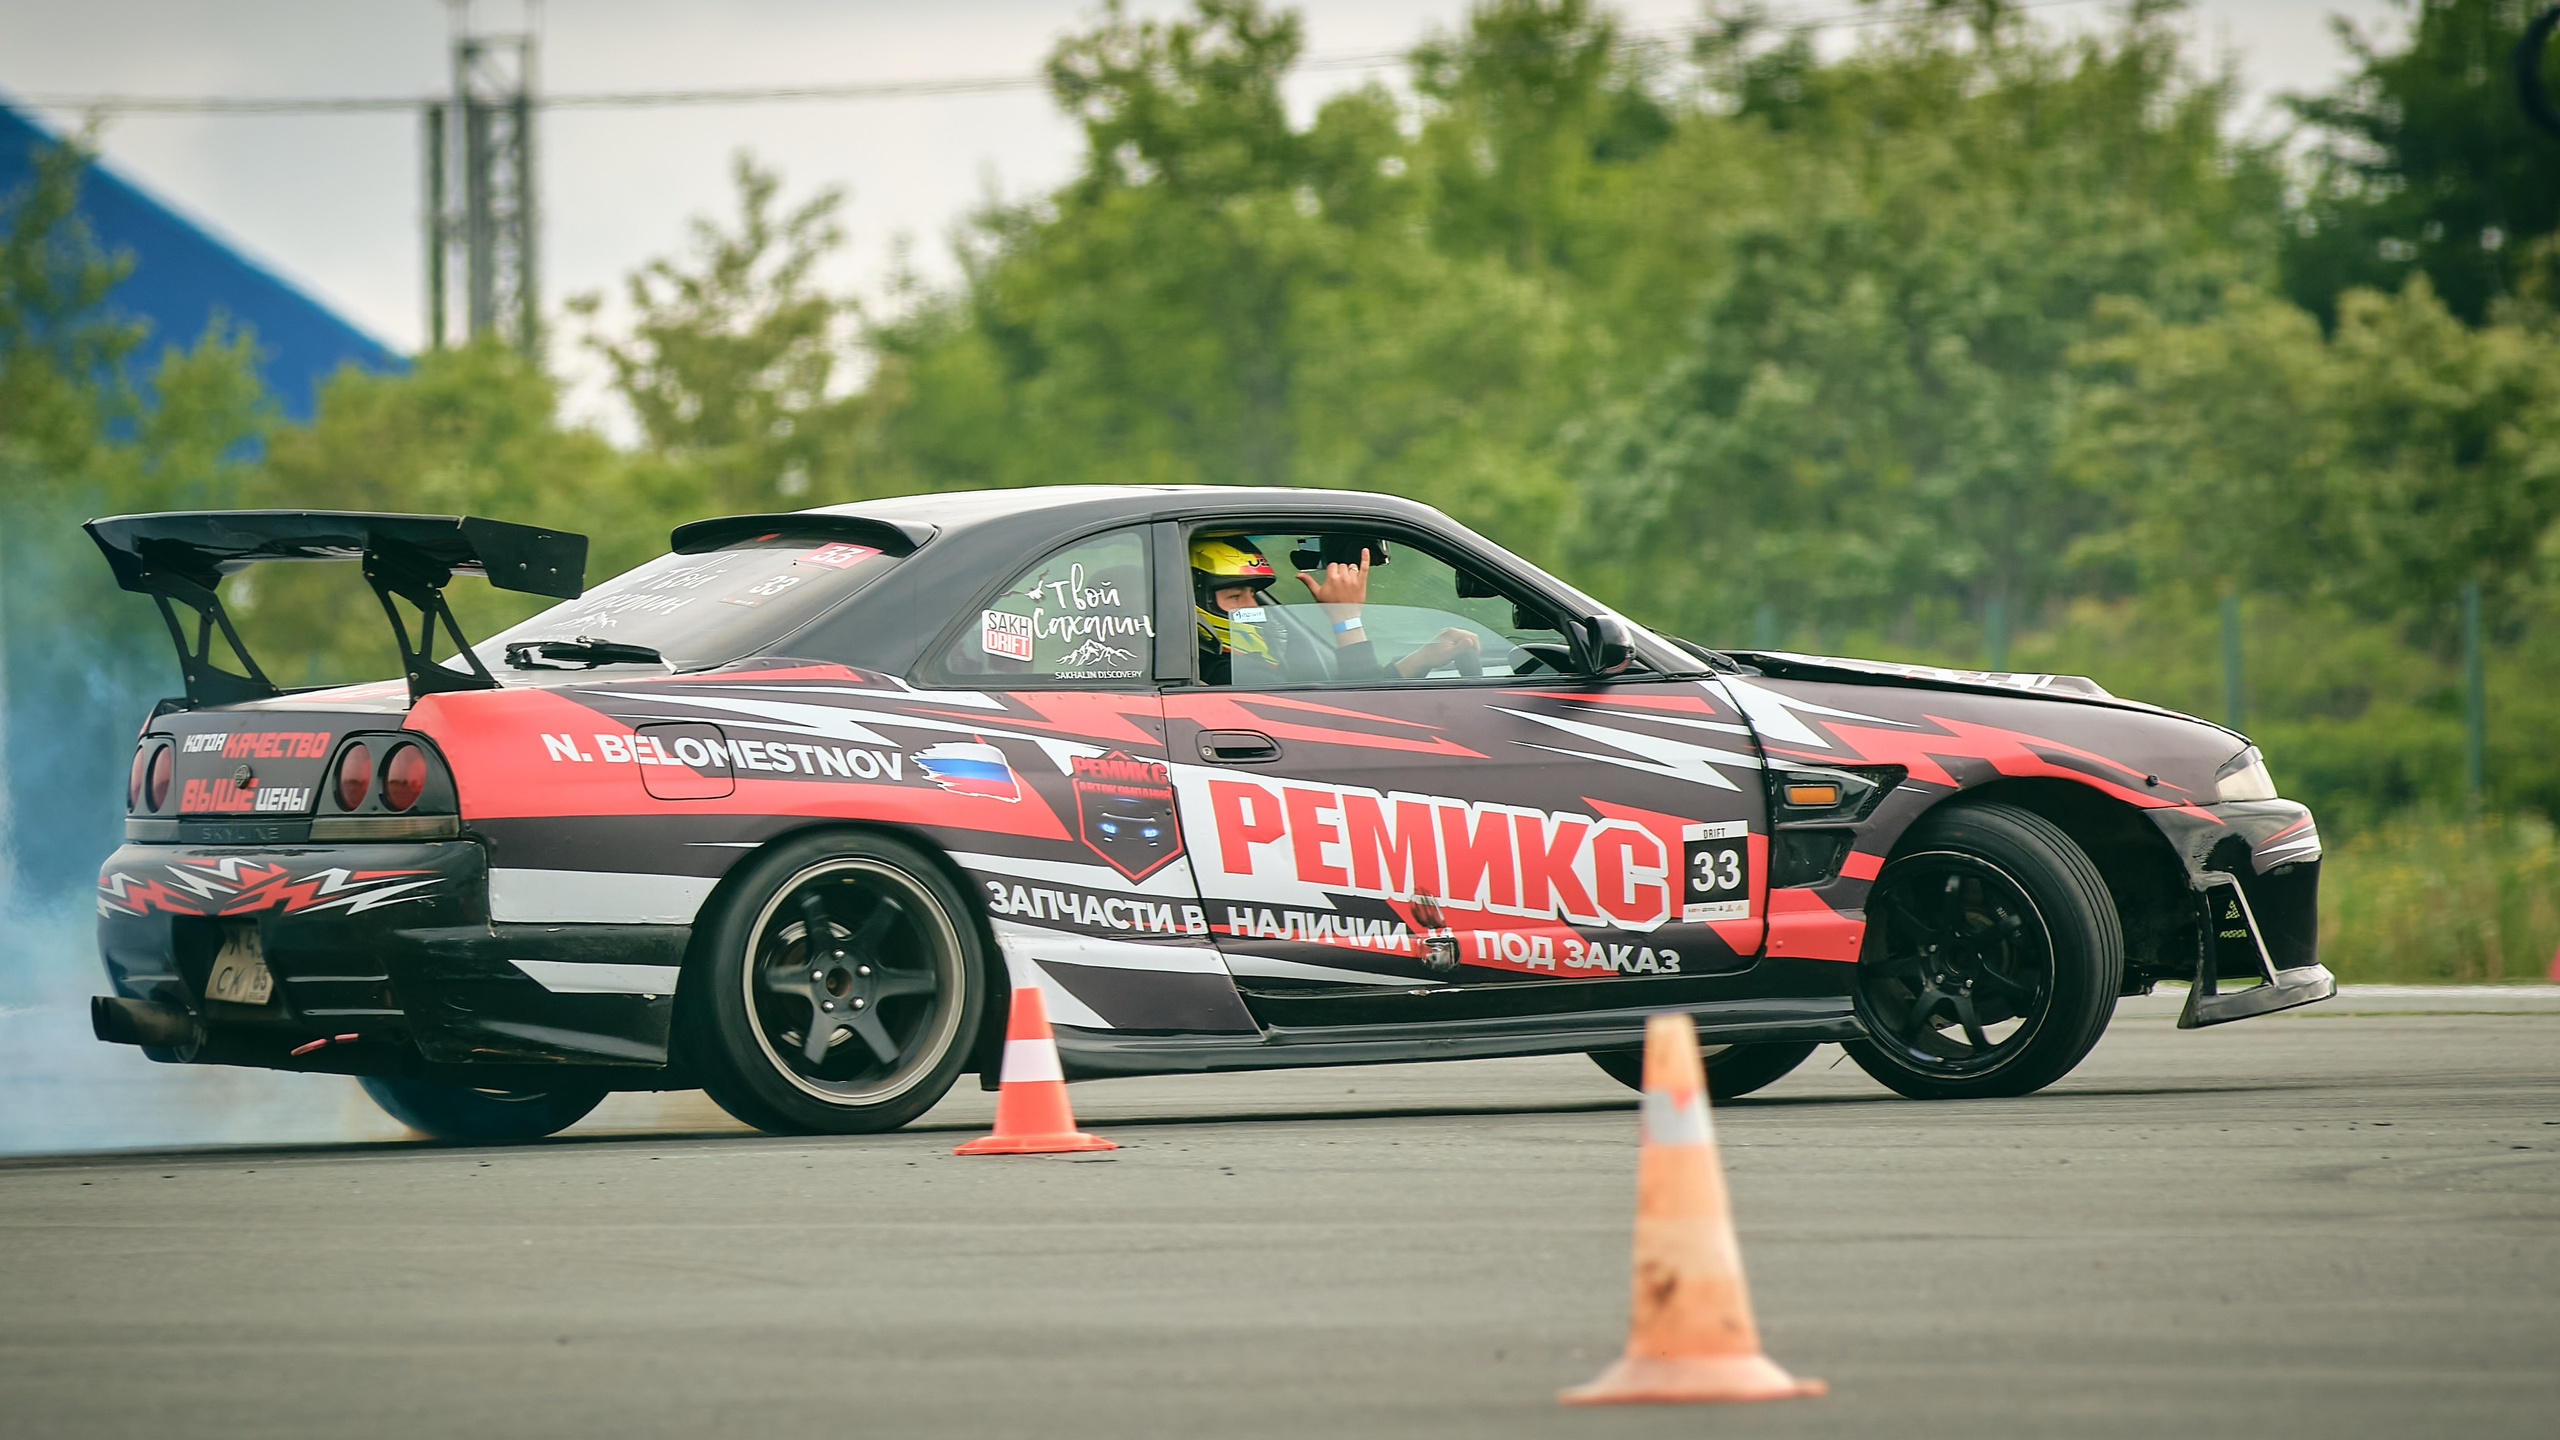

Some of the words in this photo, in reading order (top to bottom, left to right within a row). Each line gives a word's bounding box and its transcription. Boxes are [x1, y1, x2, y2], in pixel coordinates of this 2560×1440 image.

[810, 545, 867, 563] 33
[749, 575, 800, 596] 33
[1045, 562, 1121, 610] Твой
[988, 612, 1029, 636] SAKH
[1033, 607, 1156, 643] Сахалин
[988, 630, 1029, 656] DRIFT
[1055, 671, 1097, 680] SAKHALIN
[1097, 670, 1143, 679] DISCOVERY
[183, 733, 228, 753] КОГДА
[221, 732, 332, 759] КАЧЕСТВО
[540, 733, 594, 763] N.
[595, 733, 902, 781] BELOMESTNOV
[1070, 755, 1170, 785] РЕМИКС
[180, 778, 259, 813] ВЫШЕ
[255, 788, 311, 811] ЦЕНЫ
[1703, 828, 1726, 839] DRIFT
[1208, 778, 1665, 924] РЕМИКС
[1692, 849, 1742, 892] 33
[985, 880, 1177, 934] ЗАПЧАСТИ
[1181, 905, 1209, 936] В
[1226, 906, 1412, 952] НАЛИЧИИ
[1472, 929, 1556, 971] ПОД
[1562, 939, 1681, 974] ЗАКАЗ
